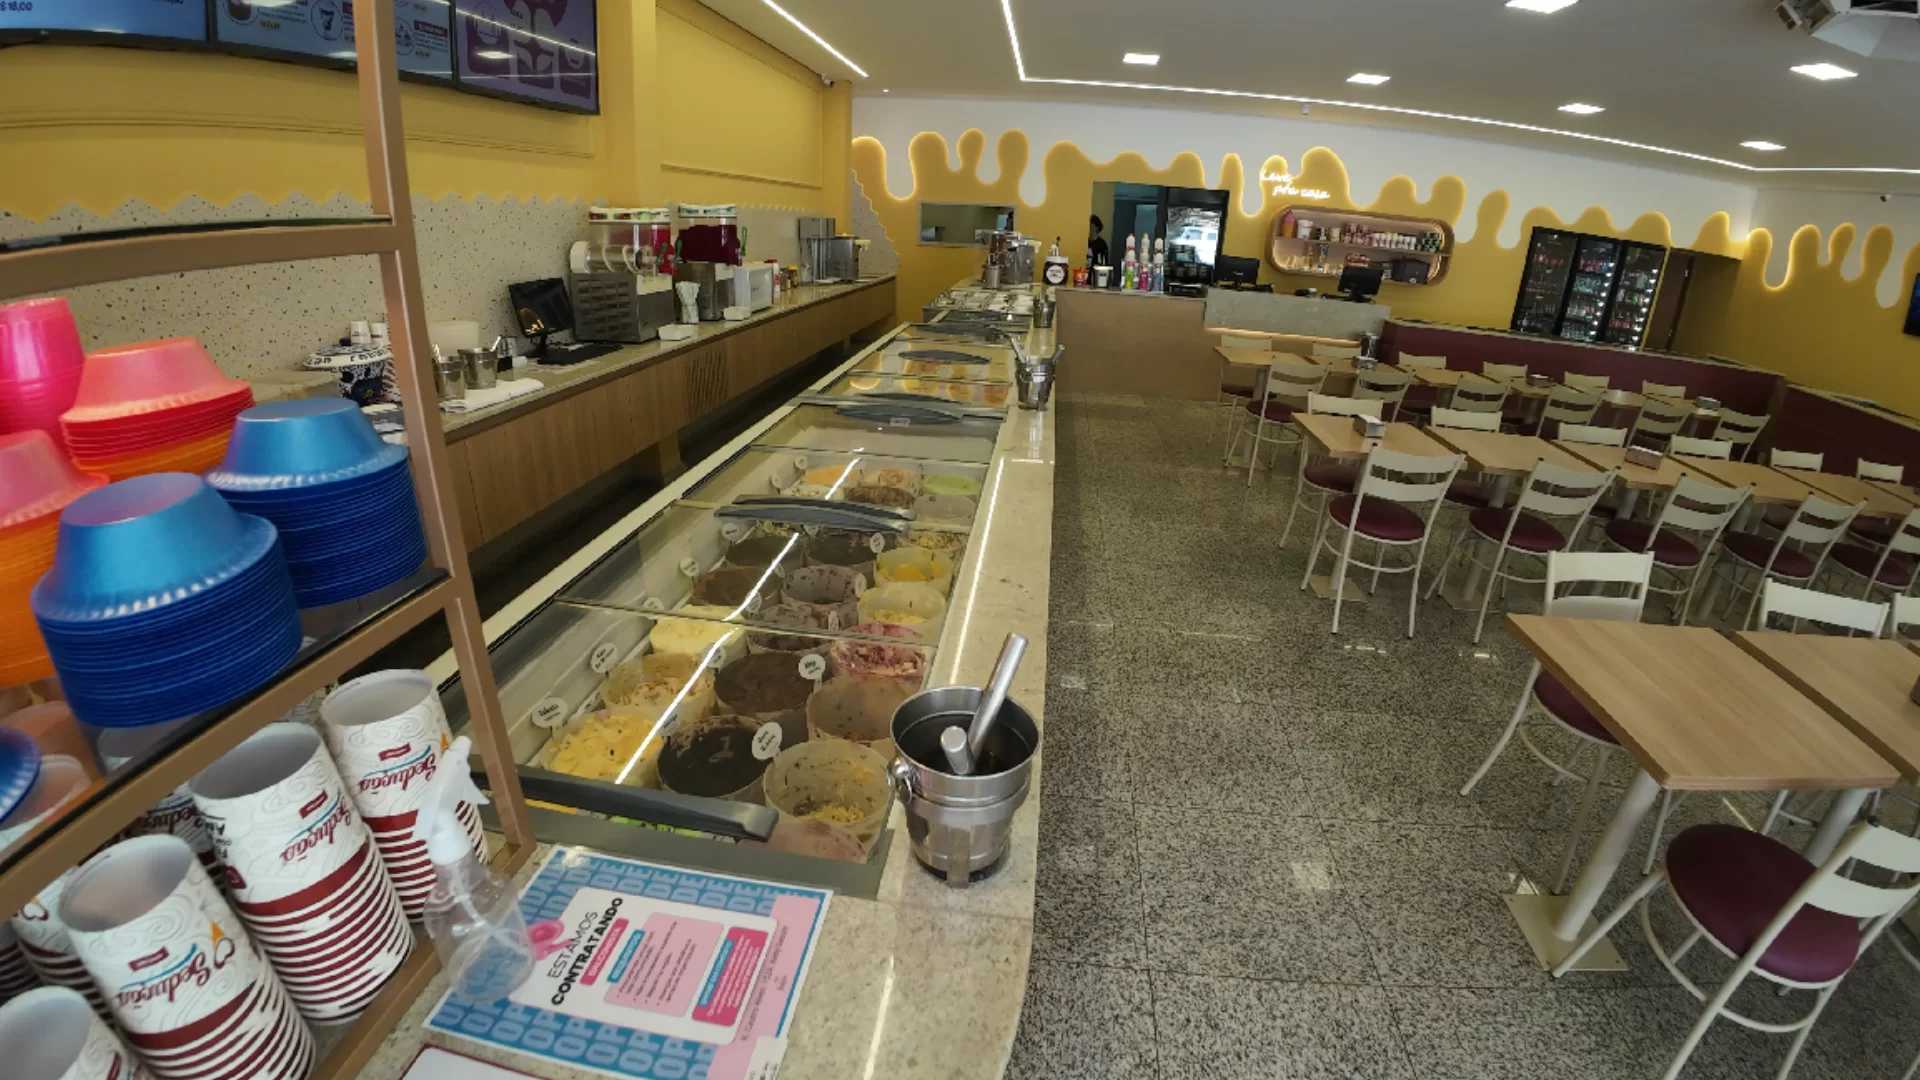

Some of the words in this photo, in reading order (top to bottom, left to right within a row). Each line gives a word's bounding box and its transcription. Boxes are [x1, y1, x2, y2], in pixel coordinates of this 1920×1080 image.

[357, 752, 437, 794] Sedução
[545, 910, 599, 979] ESTAMOS
[548, 896, 625, 1005] CONTRATANDO
[115, 952, 211, 1009] Sedução
